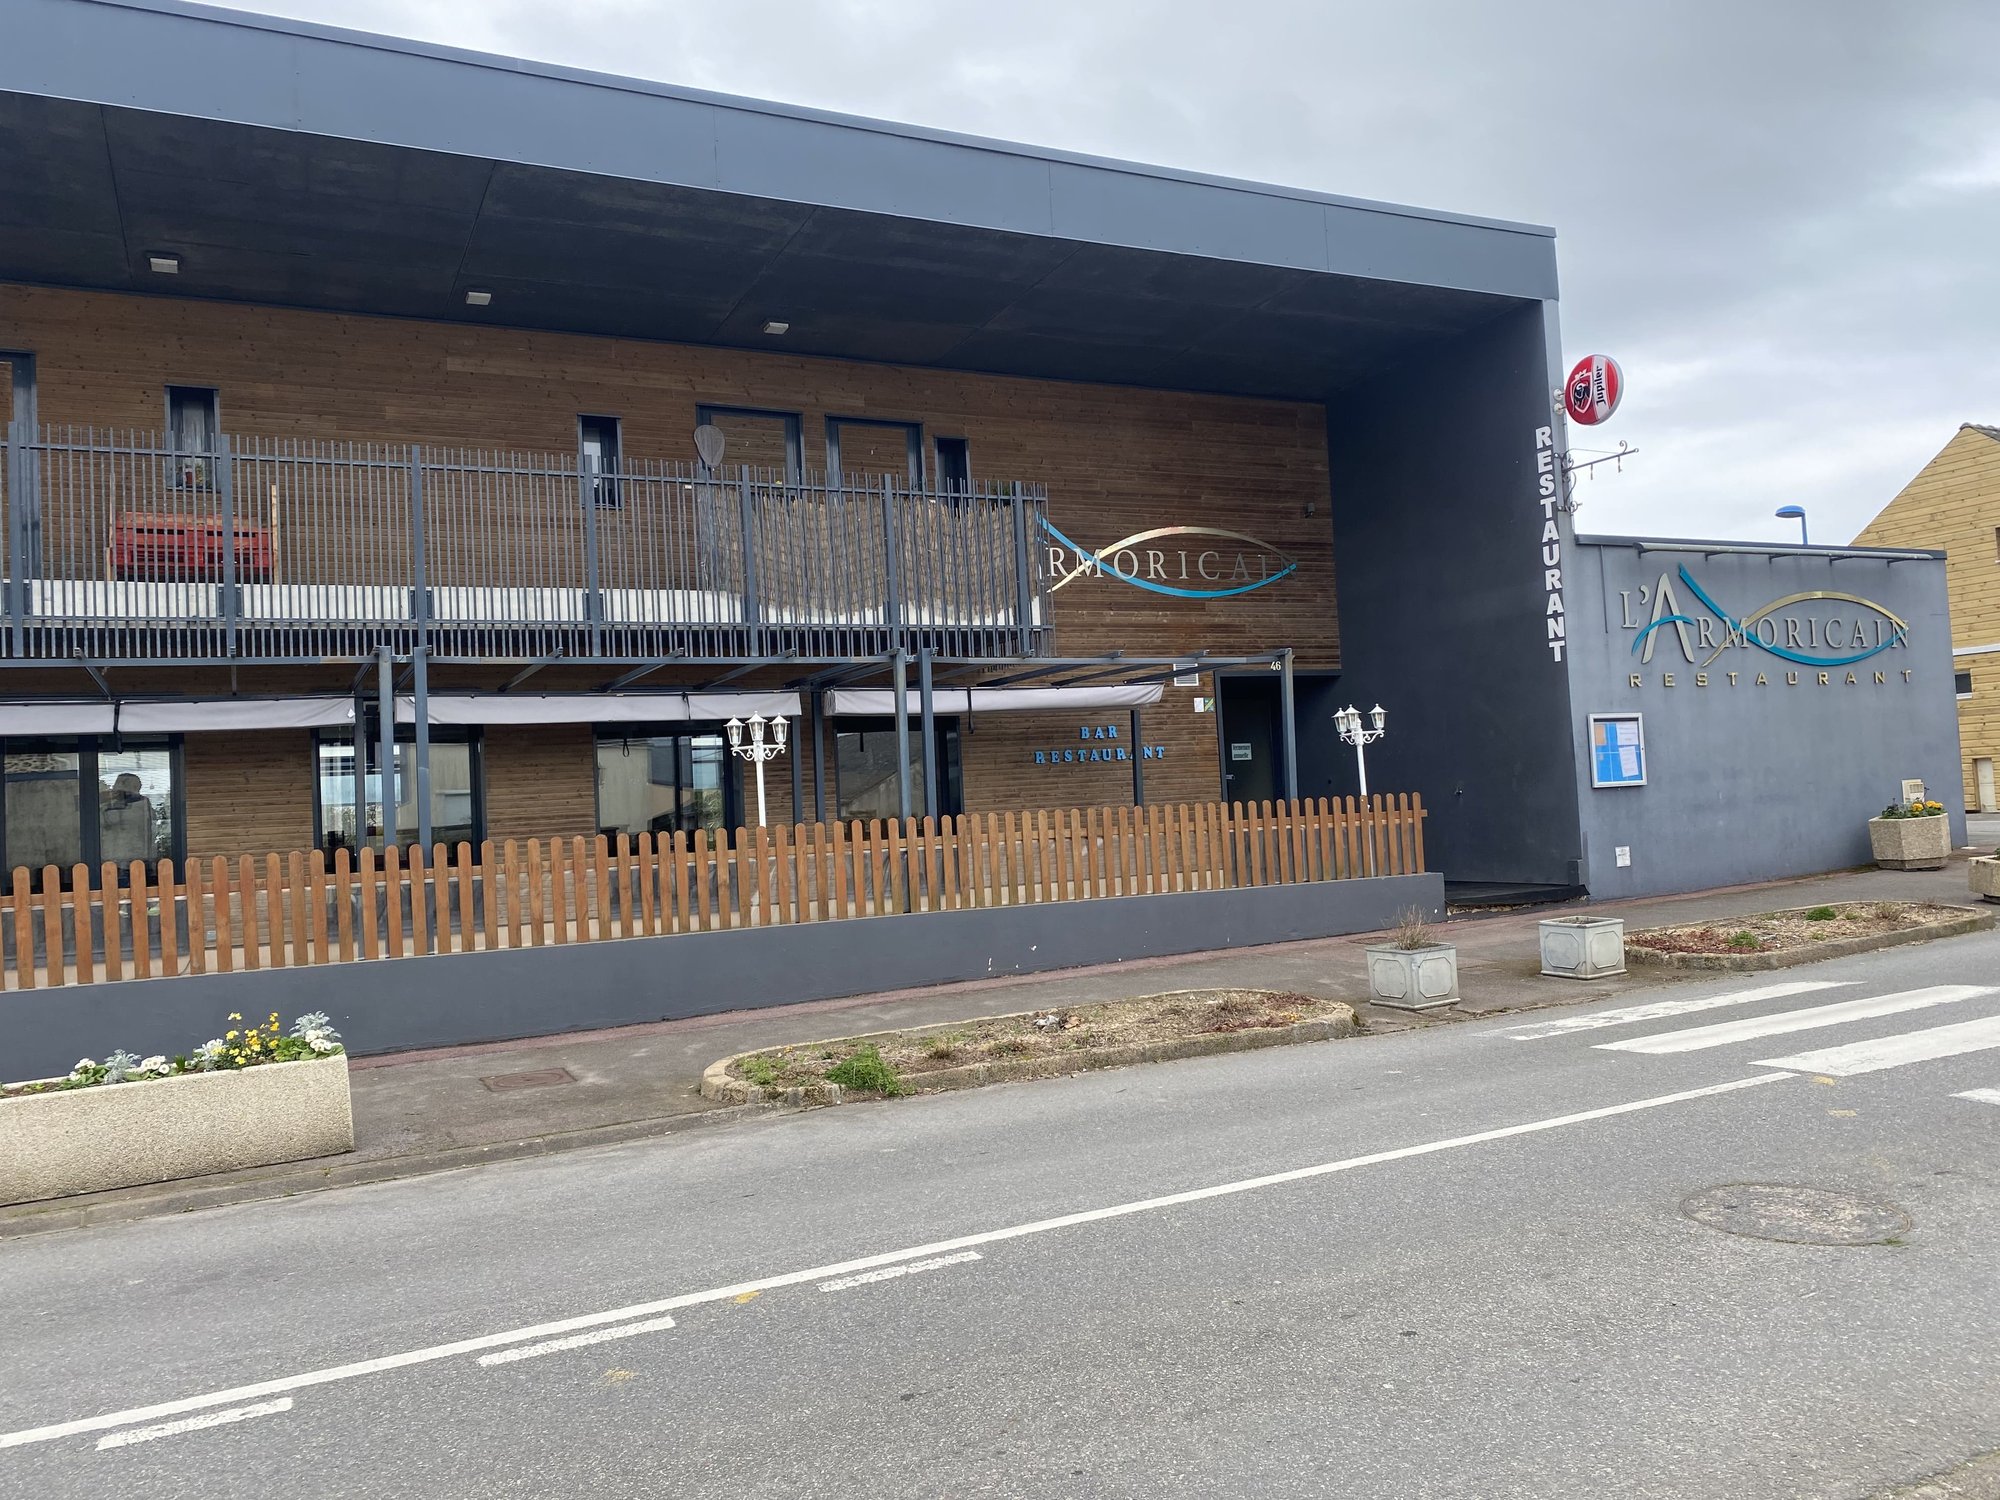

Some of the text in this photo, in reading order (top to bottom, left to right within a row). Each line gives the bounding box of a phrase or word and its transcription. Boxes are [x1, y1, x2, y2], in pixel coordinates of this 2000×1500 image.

[1594, 365, 1606, 406] Jupiler
[1535, 425, 1566, 662] RESTAURANT
[1039, 546, 1298, 582] RMORICAIN
[1270, 660, 1282, 671] 46
[1629, 669, 1912, 688] RESTAURANT
[1080, 725, 1118, 740] BAR
[1034, 745, 1165, 765] RESTAURNT
